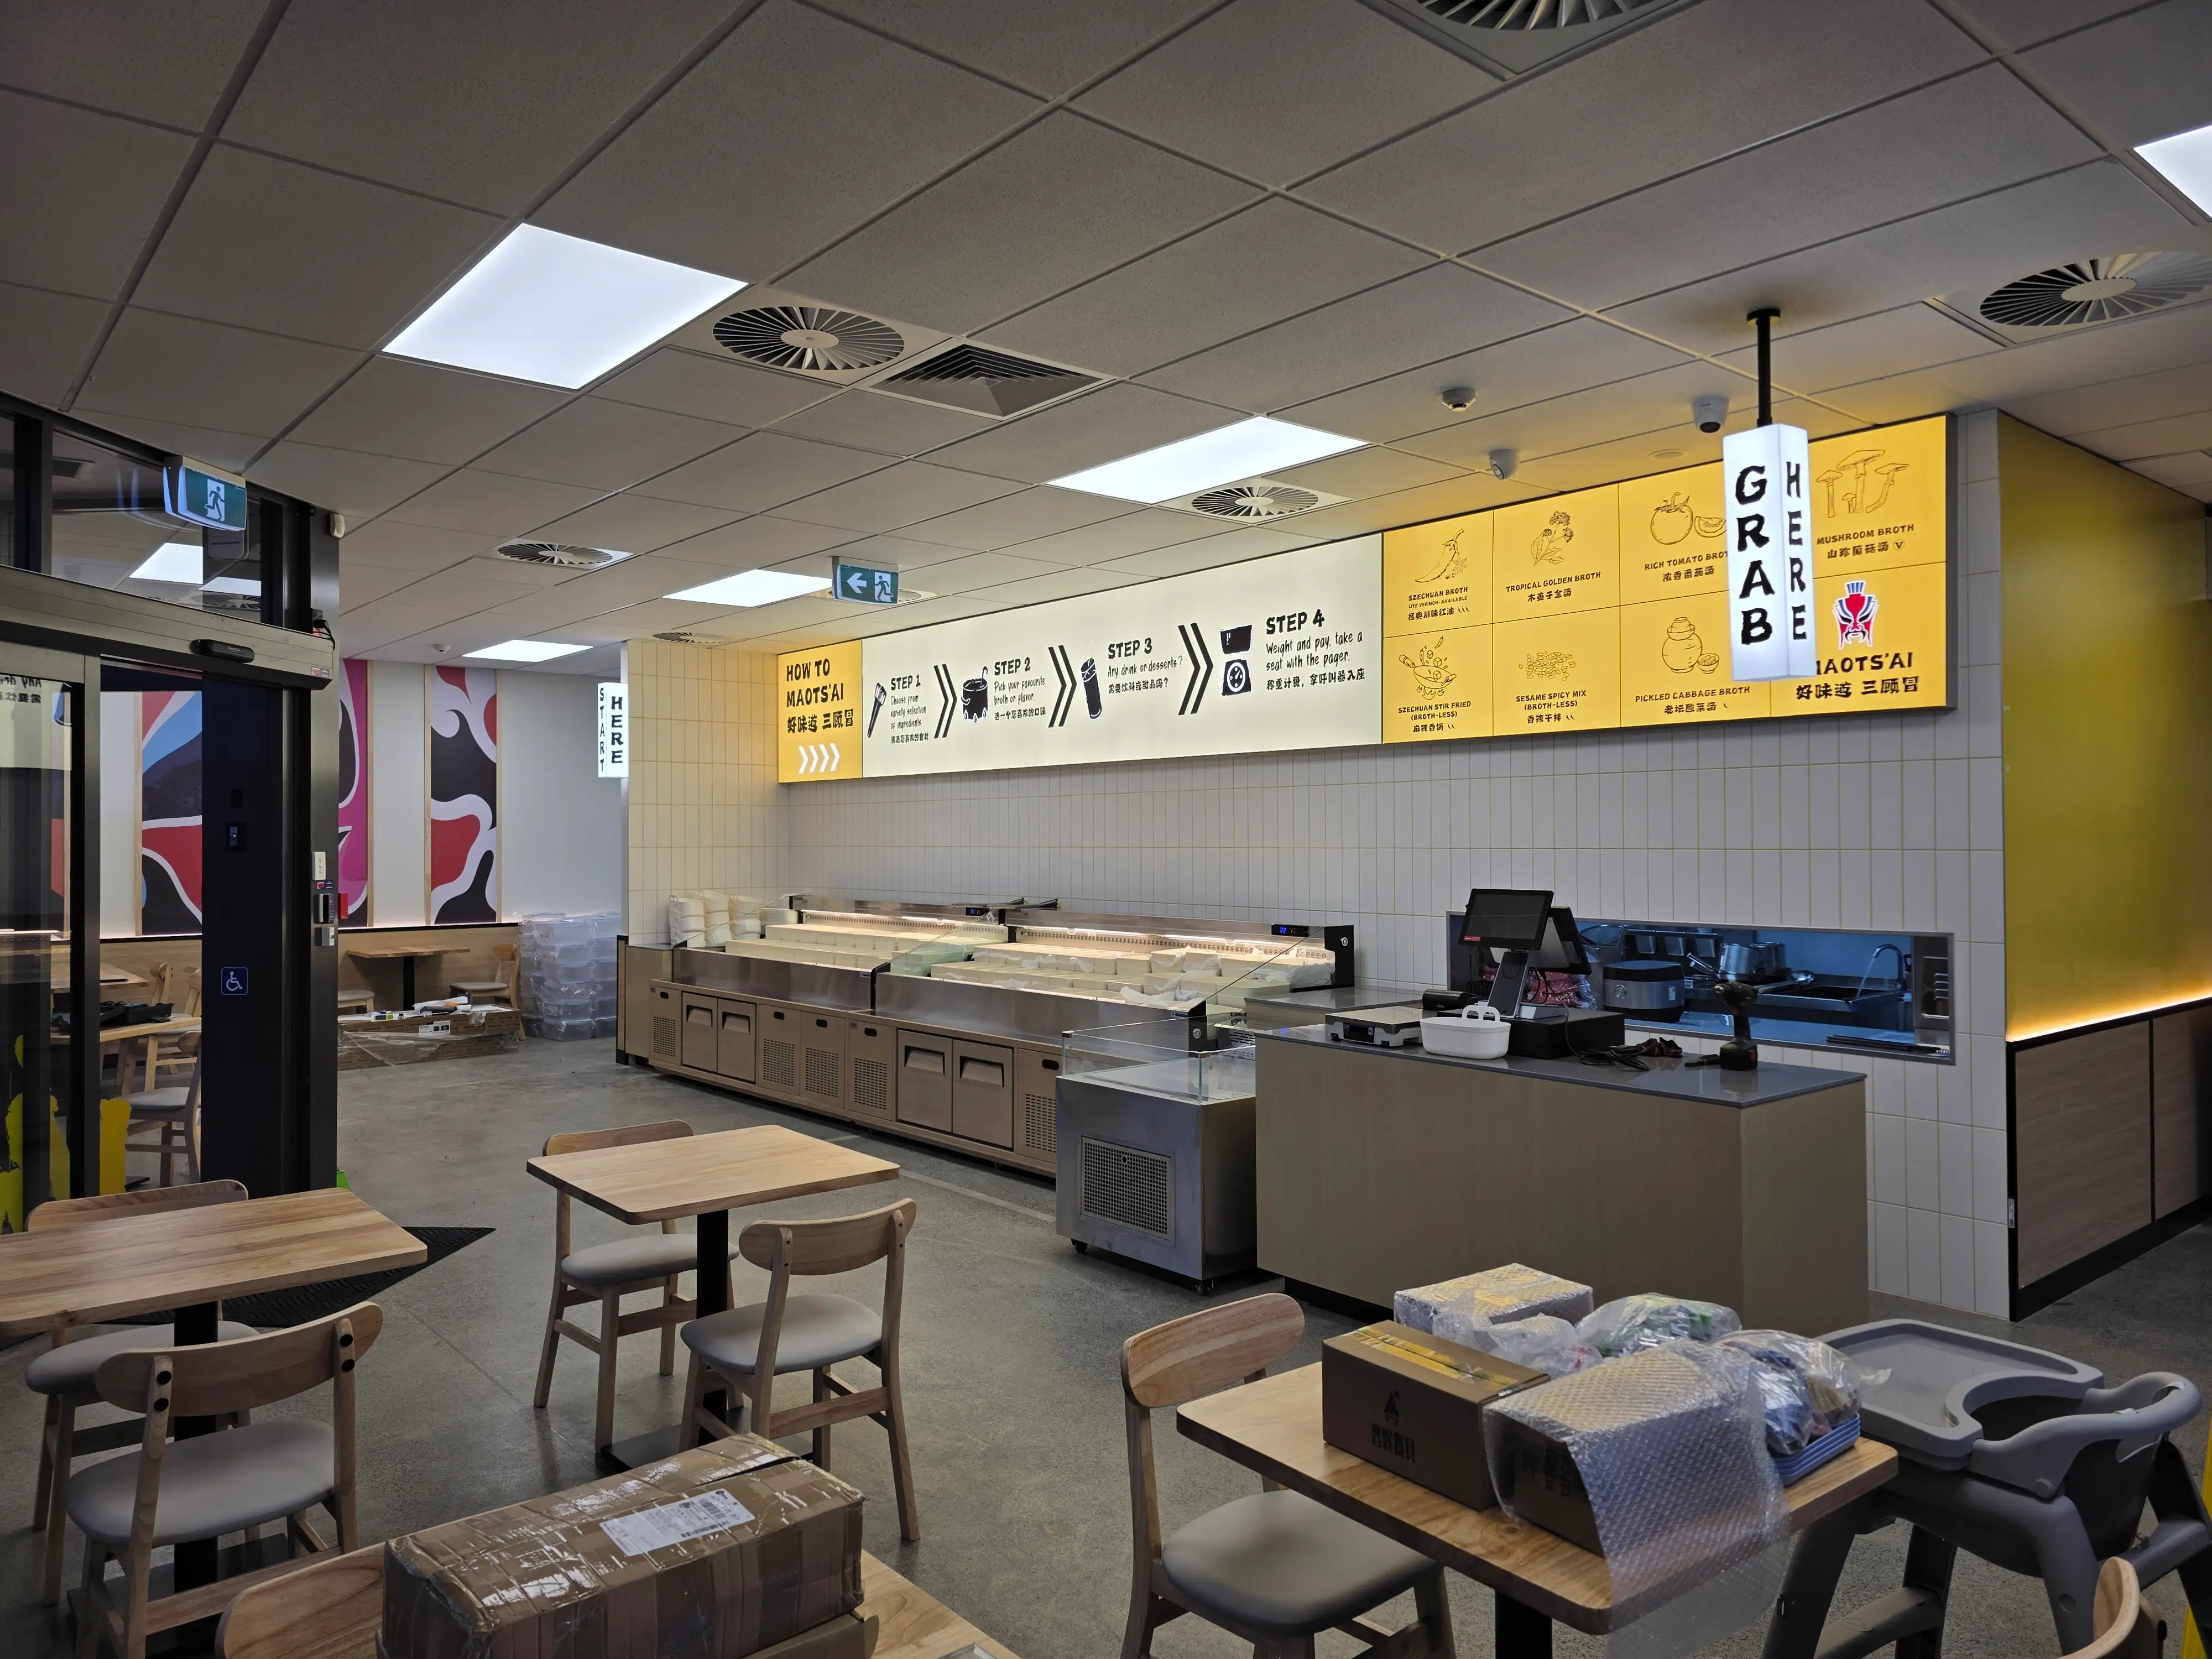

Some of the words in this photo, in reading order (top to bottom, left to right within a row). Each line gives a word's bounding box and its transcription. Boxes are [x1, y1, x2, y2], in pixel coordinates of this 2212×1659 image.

[1817, 530, 1874, 545] MUSHROOM
[1878, 524, 1914, 536] BROTH
[1735, 465, 1775, 645] GRAB
[1786, 461, 1807, 640] HERE
[1827, 541, 1889, 559] 山珍菌菇汤
[1645, 561, 1664, 570] RICH
[1667, 555, 1703, 567] TOMATO
[1706, 551, 1728, 561] BROT
[1506, 581, 1541, 592] TROPICAL
[1543, 576, 1573, 587] GOLDEN
[1575, 572, 1601, 582] BROTH
[1662, 566, 1714, 582] 浓香番茄汤
[1408, 590, 1444, 601] SZECHUAN
[1446, 586, 1468, 596] BROTH
[1441, 596, 1468, 604] AVAILABLE
[1266, 612, 1307, 635] STEP
[1312, 609, 1325, 628] 4
[1408, 607, 1454, 620] 经典川味红油
[1108, 639, 1140, 659] STEP
[1144, 637, 1152, 654] 3
[1266, 639, 1293, 658] Weight
[1297, 636, 1311, 651] and
[1315, 635, 1332, 652] pay,
[1335, 632, 1353, 645] take
[1357, 632, 1363, 643] a
[994, 658, 1021, 676] STEP
[1024, 657, 1031, 672] 2
[1266, 658, 1282, 671] seat
[1286, 654, 1302, 669] with
[1307, 653, 1319, 666] the
[1324, 651, 1350, 668] pager.
[786, 661, 811, 682] HOW
[815, 658, 830, 677] TO
[1108, 665, 1118, 679] Any
[1121, 664, 1137, 675] drink
[1140, 664, 1147, 672] or
[890, 675, 913, 691] STEP
[916, 674, 921, 687] 1
[994, 681, 1006, 692] Pick
[1008, 681, 1019, 692] your
[1022, 675, 1046, 691] favourite
[1796, 681, 1852, 700] 好味道
[1861, 676, 1919, 695] 三顾冒
[786, 683, 844, 707] MAOTS'AI
[890, 695, 906, 705] Choose
[908, 695, 919, 706] from
[994, 694, 1008, 706] broth
[1018, 692, 1035, 705] flavor.
[1516, 693, 1546, 702] SESAME
[1548, 691, 1570, 700] SPICY
[1635, 693, 1670, 702] PICKLED
[1673, 689, 1717, 700] CABBAGE
[1719, 686, 1750, 696] BROTH
[890, 707, 905, 718] variety
[907, 705, 926, 716] selection
[1398, 705, 1433, 713] SZECHUAN
[1524, 700, 1578, 711] (BROTH-LESS)
[1664, 702, 1716, 714] 老坛酸菜汤
[787, 714, 818, 733] 好味道
[822, 708, 854, 729] 三顾冒
[890, 722, 895, 732] of
[897, 717, 922, 732] ingredients.
[1411, 711, 1457, 721] (BROTH-LESS)
[1527, 713, 1561, 724] 香辣干拌
[611, 696, 624, 764] HERE
[1413, 723, 1443, 733] 麻辣香锅
